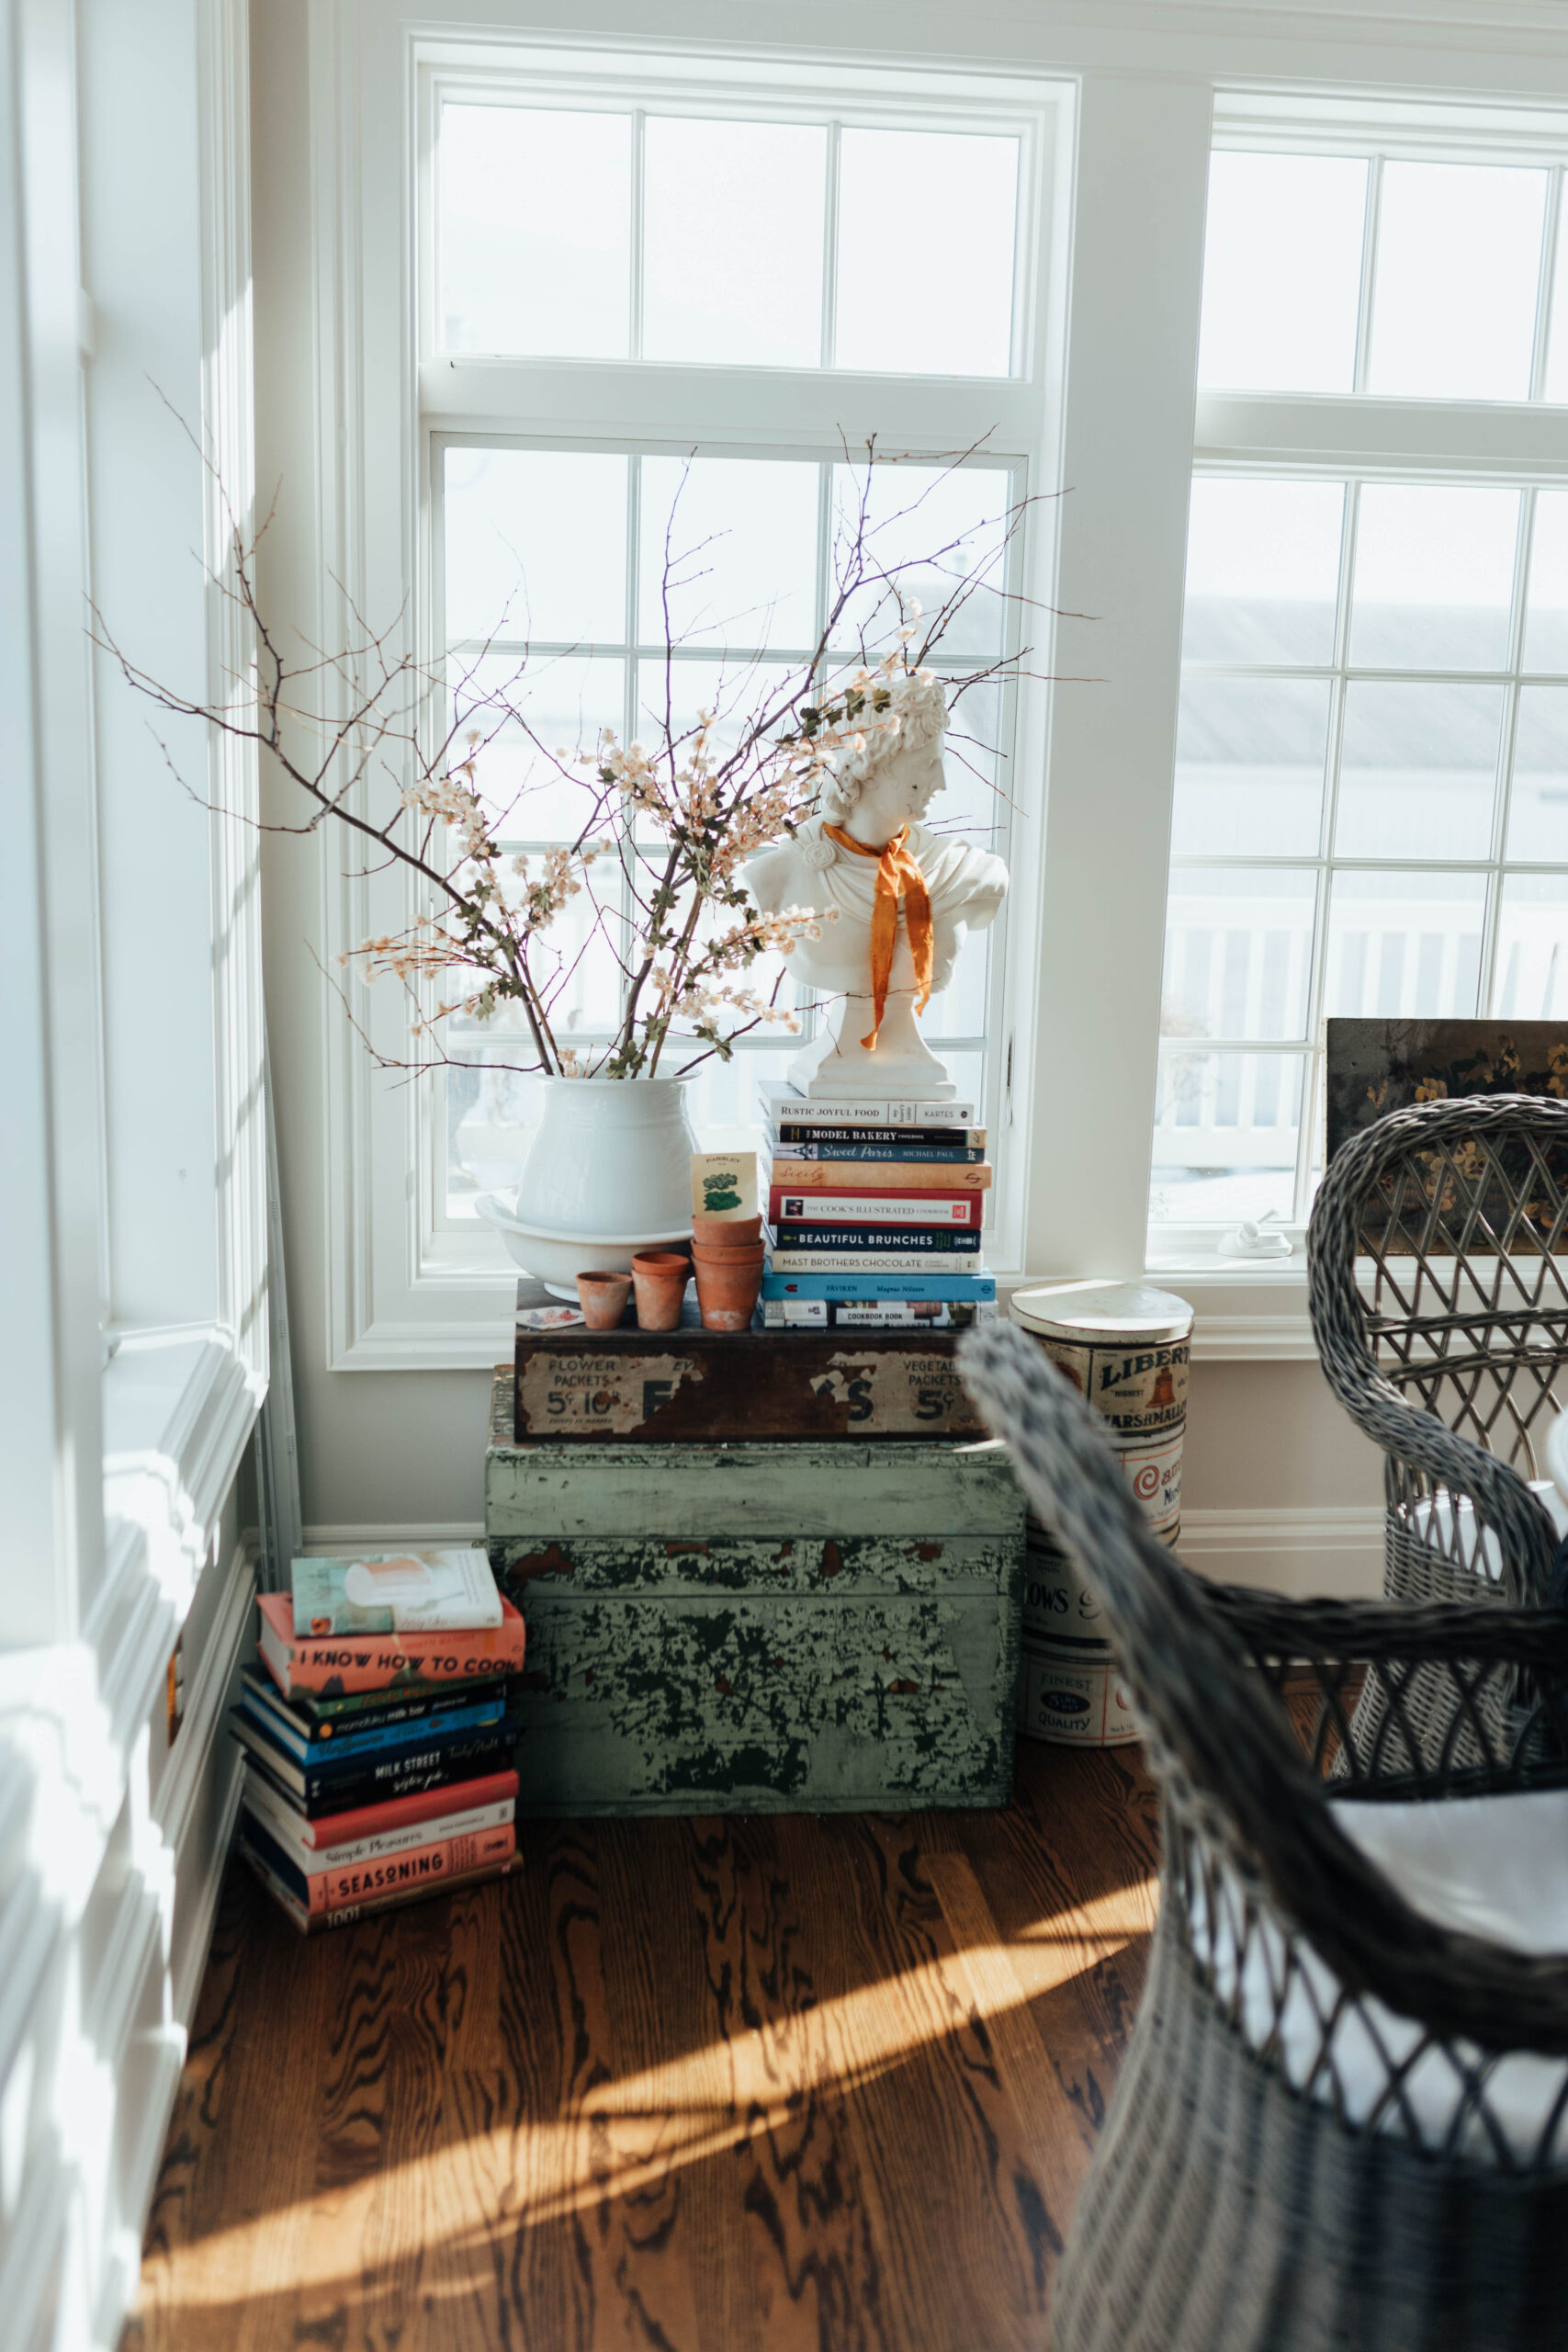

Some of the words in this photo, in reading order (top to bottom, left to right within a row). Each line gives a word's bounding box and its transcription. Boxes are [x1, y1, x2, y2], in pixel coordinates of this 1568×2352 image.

[781, 1106, 815, 1116] RUSTIC
[817, 1108, 852, 1117] JOYFUL
[855, 1109, 880, 1117] FOOD
[924, 1110, 954, 1118] KARTES
[812, 1129, 850, 1140] MODEL
[852, 1131, 897, 1141] BAKERY
[822, 1143, 858, 1159] Sweet
[862, 1145, 894, 1159] Paris
[780, 1166, 826, 1183] Sicily
[820, 1204, 854, 1214] COOK'S
[856, 1205, 915, 1215] ILLUSTRATED
[799, 1233, 863, 1244] BEAUTIFUL
[868, 1235, 933, 1246] BRUNCHES
[783, 1258, 808, 1266] MAST
[810, 1258, 861, 1267] BROTHERS
[863, 1259, 922, 1268] CHOCOLATE
[847, 1312, 884, 1320] COOKBOOK
[548, 1360, 615, 1372] FLOWER
[903, 1361, 957, 1372] VEGETAB
[1100, 1346, 1190, 1391] LIBERT
[554, 1374, 609, 1386] PACKETS
[908, 1374, 962, 1386] PACKETS
[1028, 1582, 1069, 1614] OWS
[299, 1650, 306, 1665] I
[312, 1651, 372, 1668] KNOW
[378, 1653, 425, 1670] HOW
[432, 1656, 457, 1672] TO
[464, 1658, 518, 1673] COOK
[1041, 1671, 1093, 1692] FINEST
[409, 1704, 426, 1717] bar
[1038, 1712, 1091, 1732] QUALITY
[374, 1759, 401, 1780] MILK
[402, 1750, 442, 1773] STREET
[325, 1843, 367, 1865] Simple
[337, 1852, 444, 1898] SEASONING
